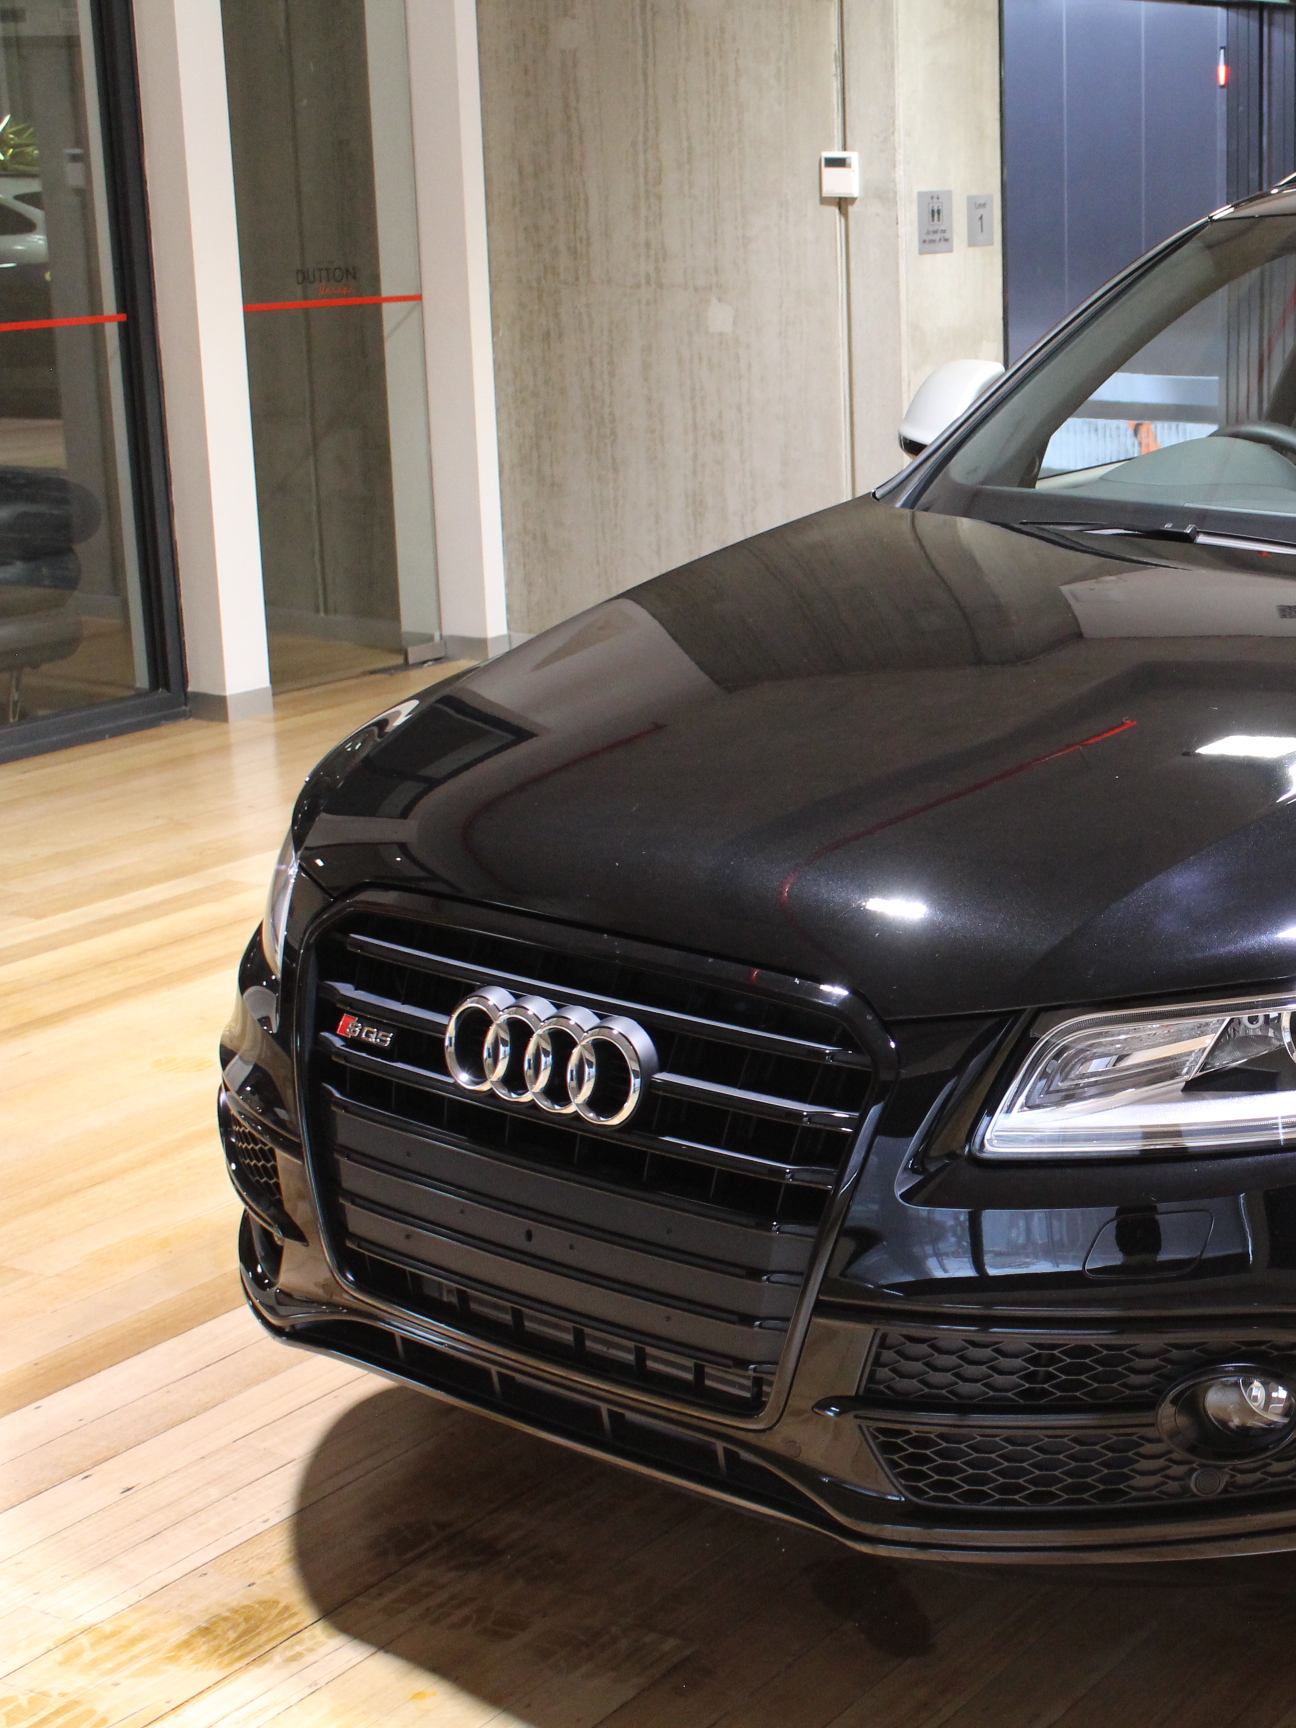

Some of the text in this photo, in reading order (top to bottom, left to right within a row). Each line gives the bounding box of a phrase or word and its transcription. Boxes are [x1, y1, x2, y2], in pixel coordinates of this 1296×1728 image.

[978, 213, 984, 233] 1
[296, 264, 357, 285] DUTTON
[344, 1021, 394, 1047] SQ5
